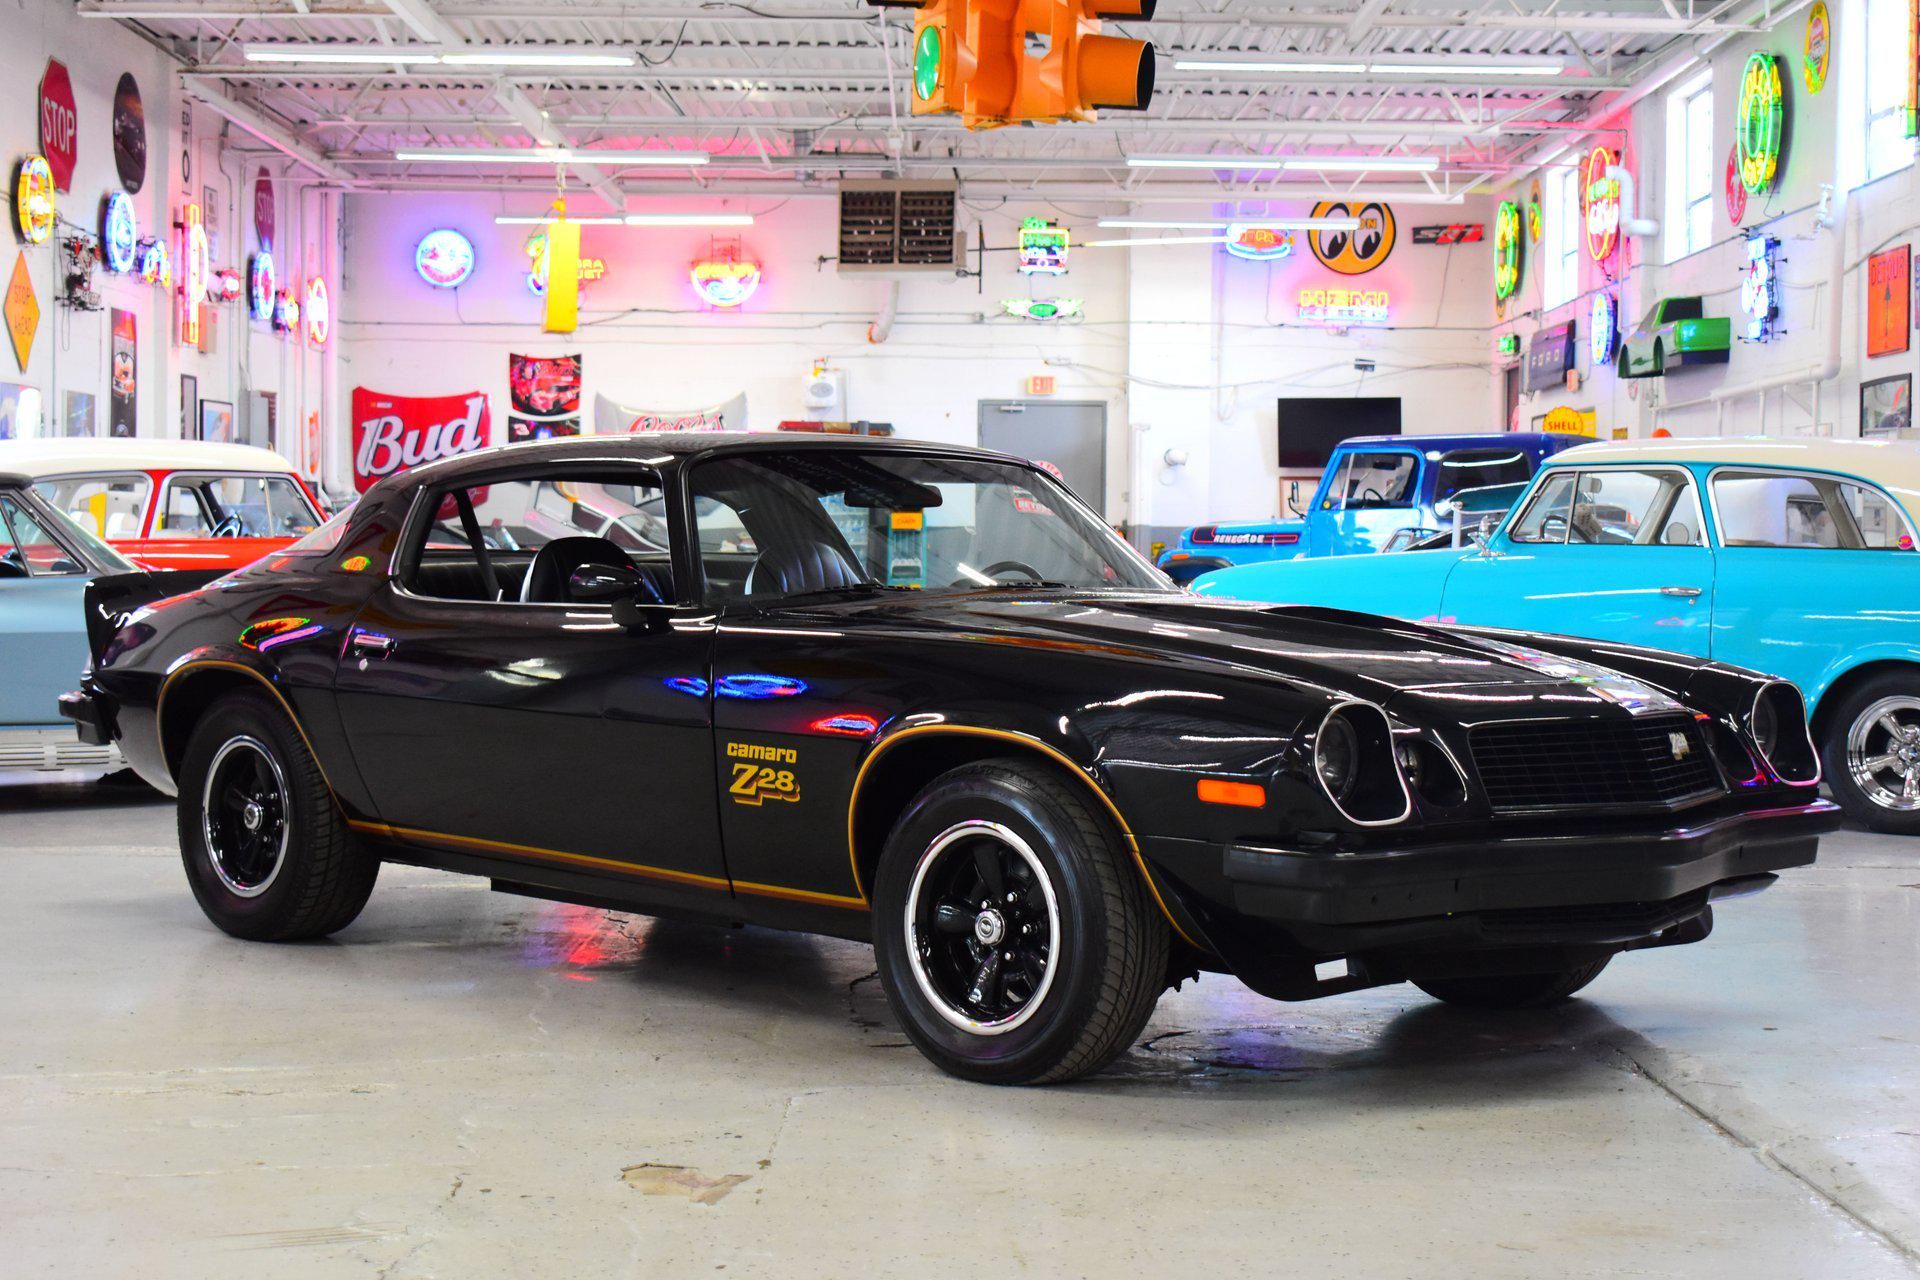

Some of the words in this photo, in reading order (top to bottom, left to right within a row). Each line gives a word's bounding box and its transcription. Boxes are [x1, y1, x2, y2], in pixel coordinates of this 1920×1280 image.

[44, 96, 75, 155] STOP
[1415, 227, 1482, 241] SRT
[1870, 256, 1905, 286] DETOUR
[1300, 290, 1389, 306] HEMI
[1532, 349, 1560, 368] FORD
[1548, 421, 1577, 431] SHELL
[356, 396, 485, 477] Bud
[1213, 533, 1265, 544] RENEGADE
[727, 742, 797, 764] camaro
[729, 763, 800, 806] Z28
